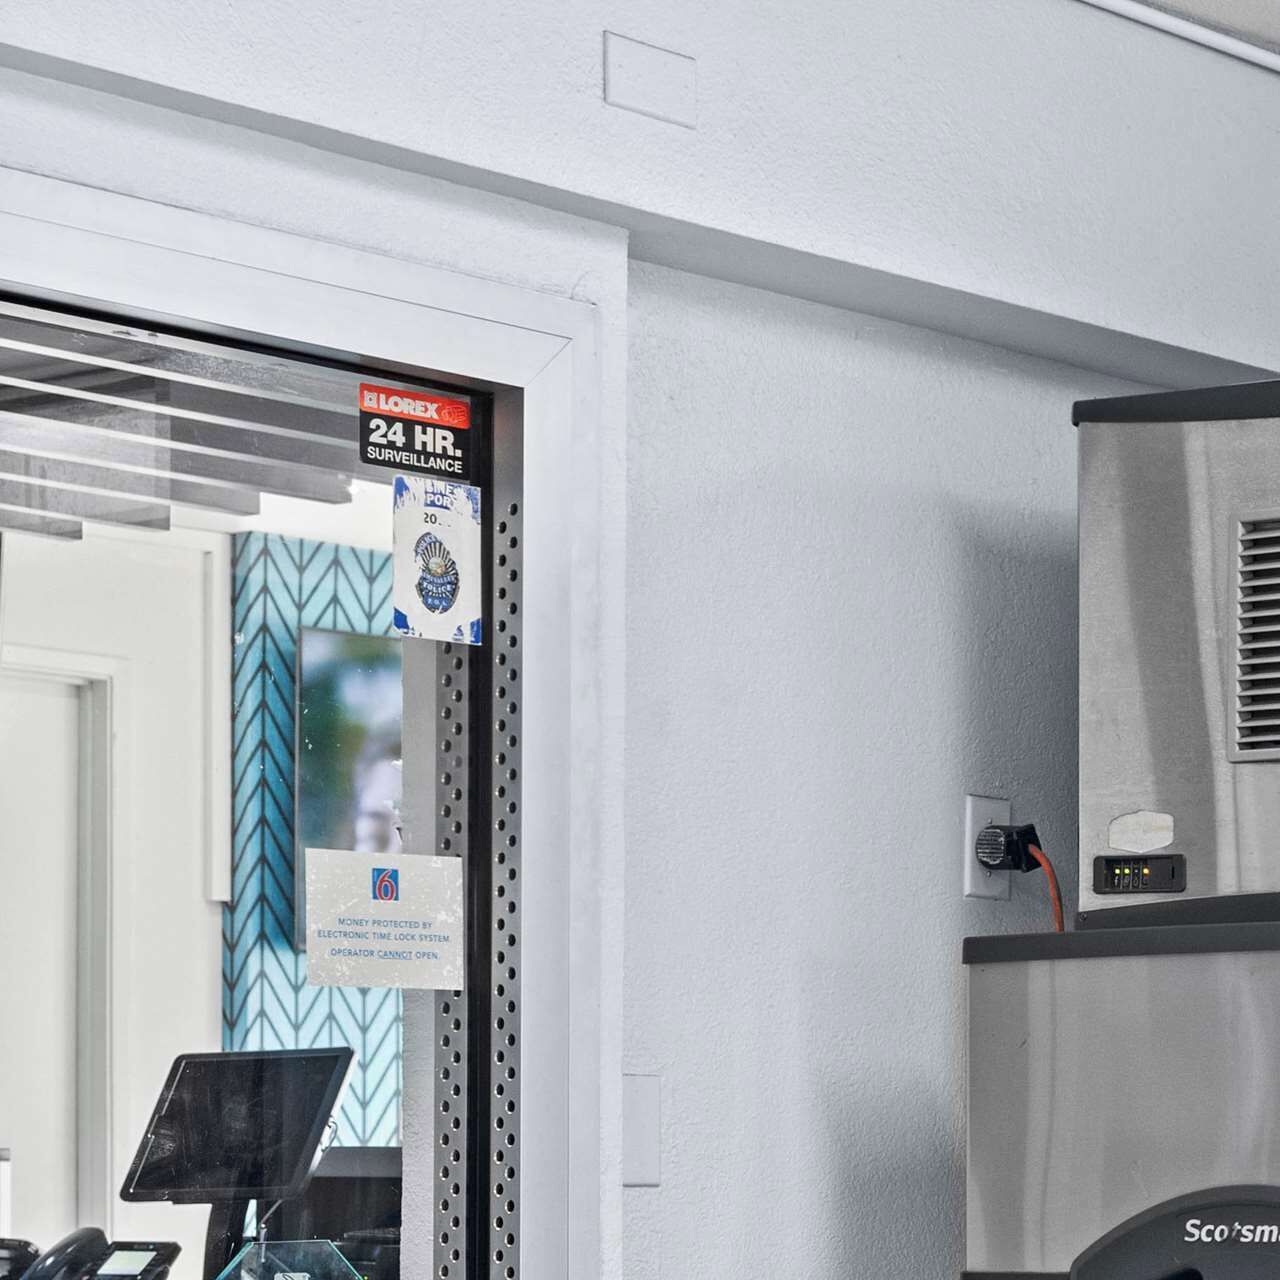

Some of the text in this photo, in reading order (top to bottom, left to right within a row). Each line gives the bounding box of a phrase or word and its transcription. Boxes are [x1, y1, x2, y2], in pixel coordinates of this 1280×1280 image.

[378, 393, 440, 420] LOREX
[369, 418, 462, 456] 24 HR.
[367, 446, 462, 473] SURVEILLANCE
[376, 869, 396, 901] 6
[318, 930, 369, 939] ELECTRONIC
[373, 932, 392, 940] TIME
[395, 933, 416, 941] LOCK
[338, 918, 432, 929] MONEY PROTECTED BY
[331, 949, 374, 957] OPERATOR
[377, 950, 413, 960] CANNOT
